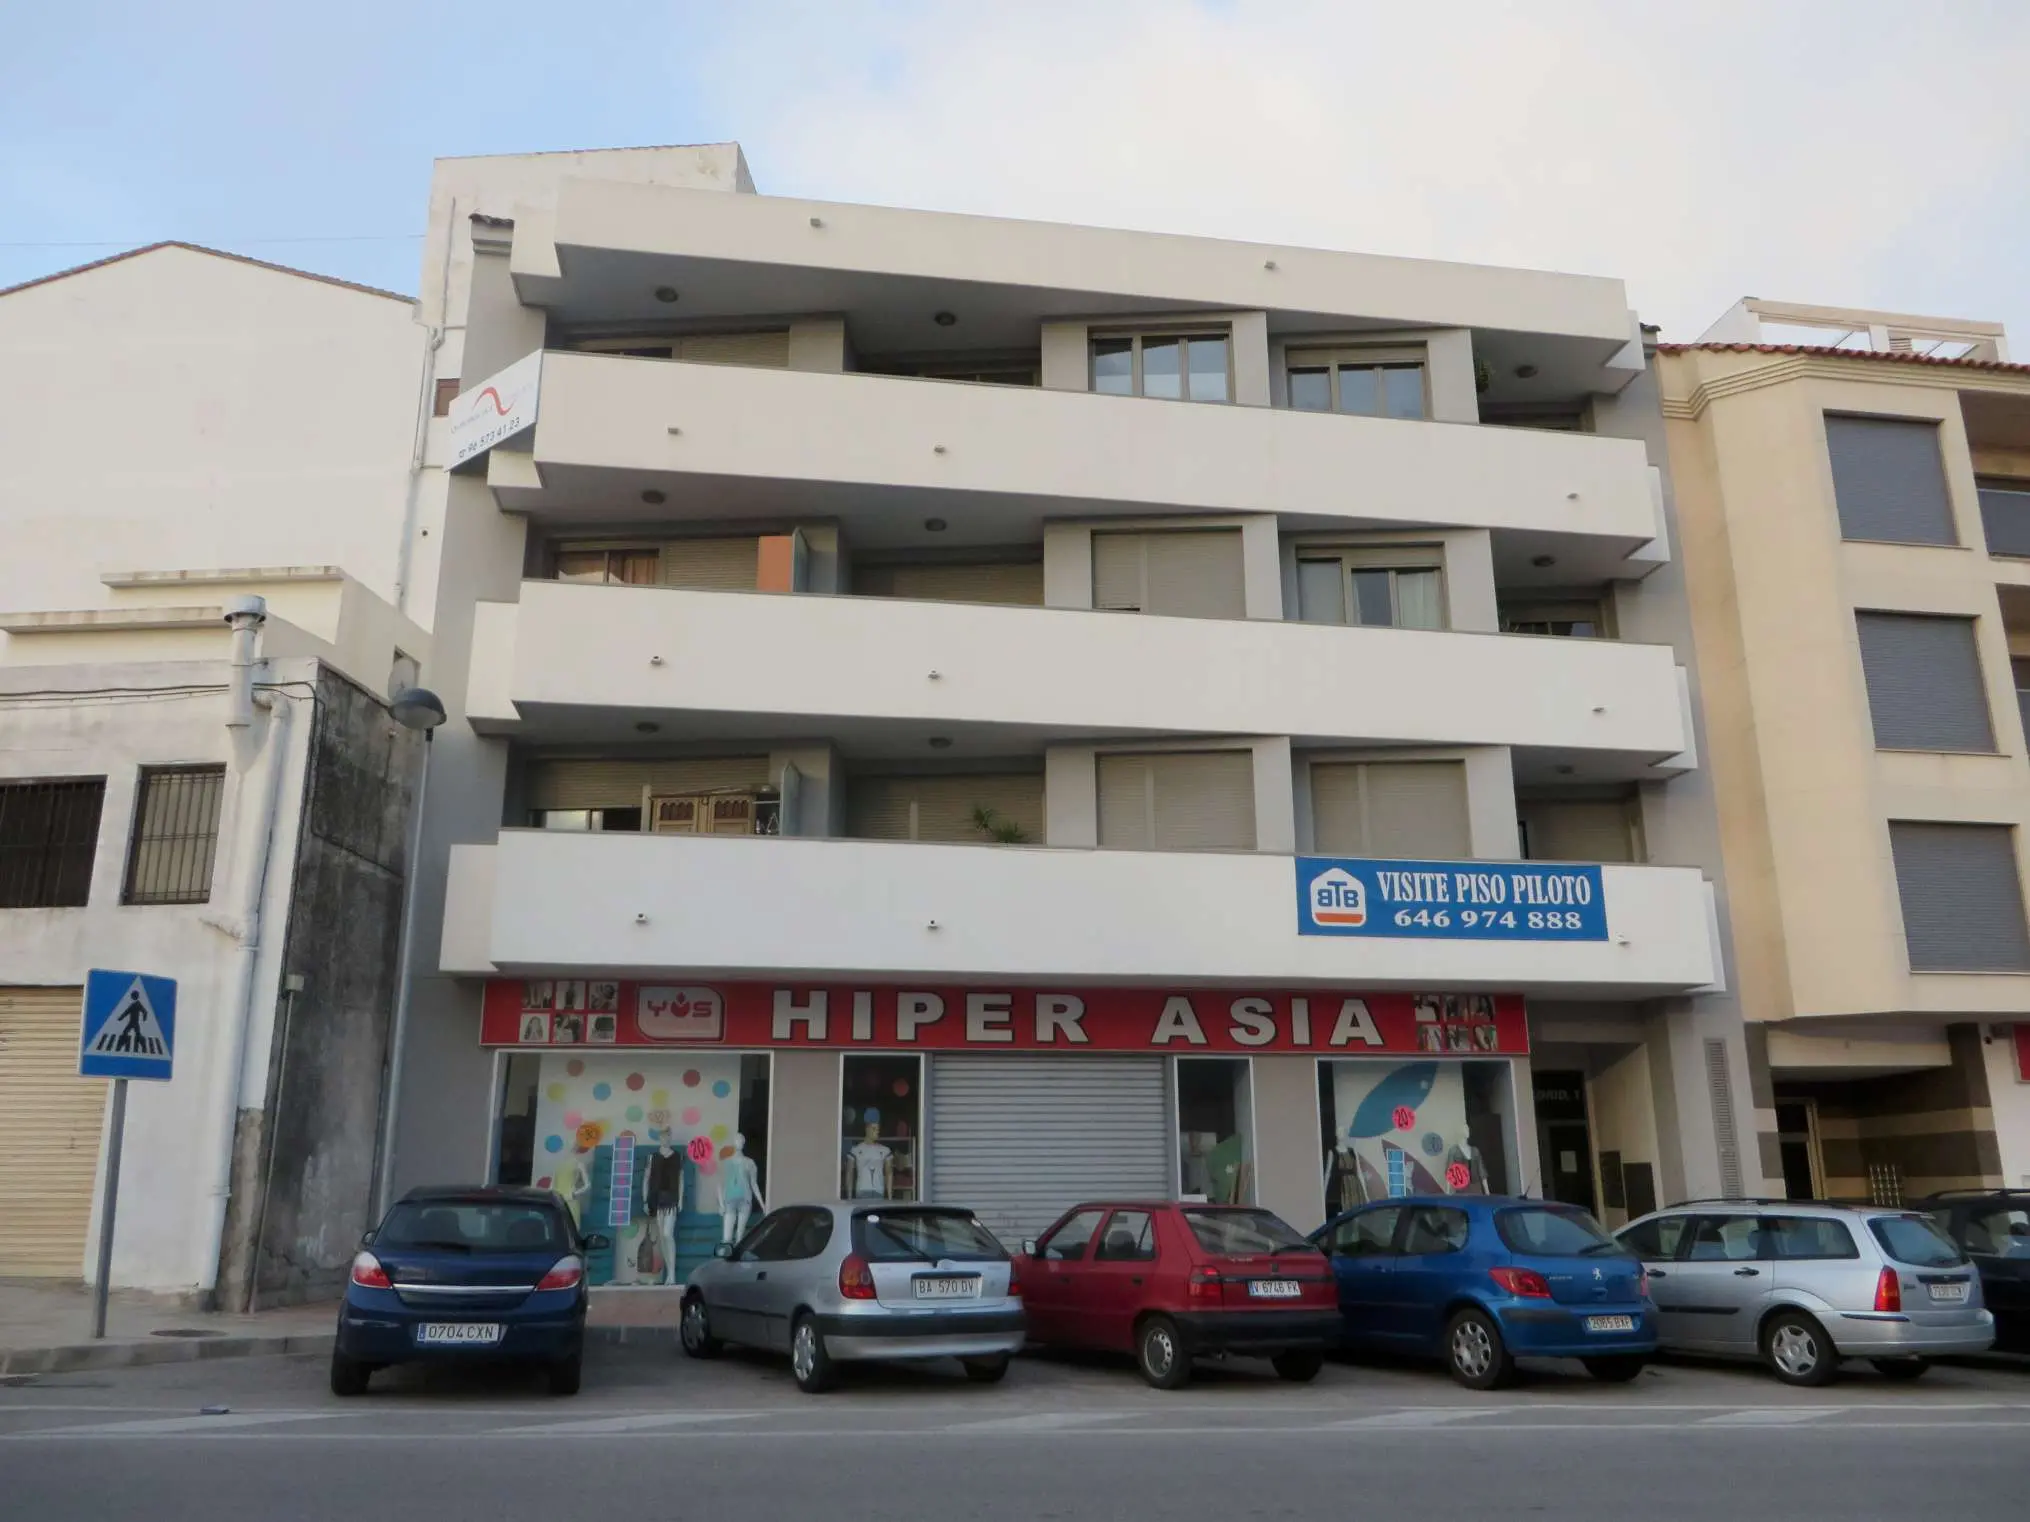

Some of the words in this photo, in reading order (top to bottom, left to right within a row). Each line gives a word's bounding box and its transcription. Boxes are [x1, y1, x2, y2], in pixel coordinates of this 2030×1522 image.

[1376, 871, 1449, 903] VISITE
[1456, 873, 1506, 904] PISO
[1512, 874, 1591, 905] PILOTO
[1394, 909, 1450, 927] 646
[1461, 910, 1517, 928] 974
[1527, 911, 1582, 929] 888
[771, 989, 1089, 1043] HIPER
[1151, 995, 1385, 1047] ASIA
[938, 1280, 958, 1295] 570
[428, 1325, 463, 1339] 0704
[467, 1325, 495, 1339] CXN
